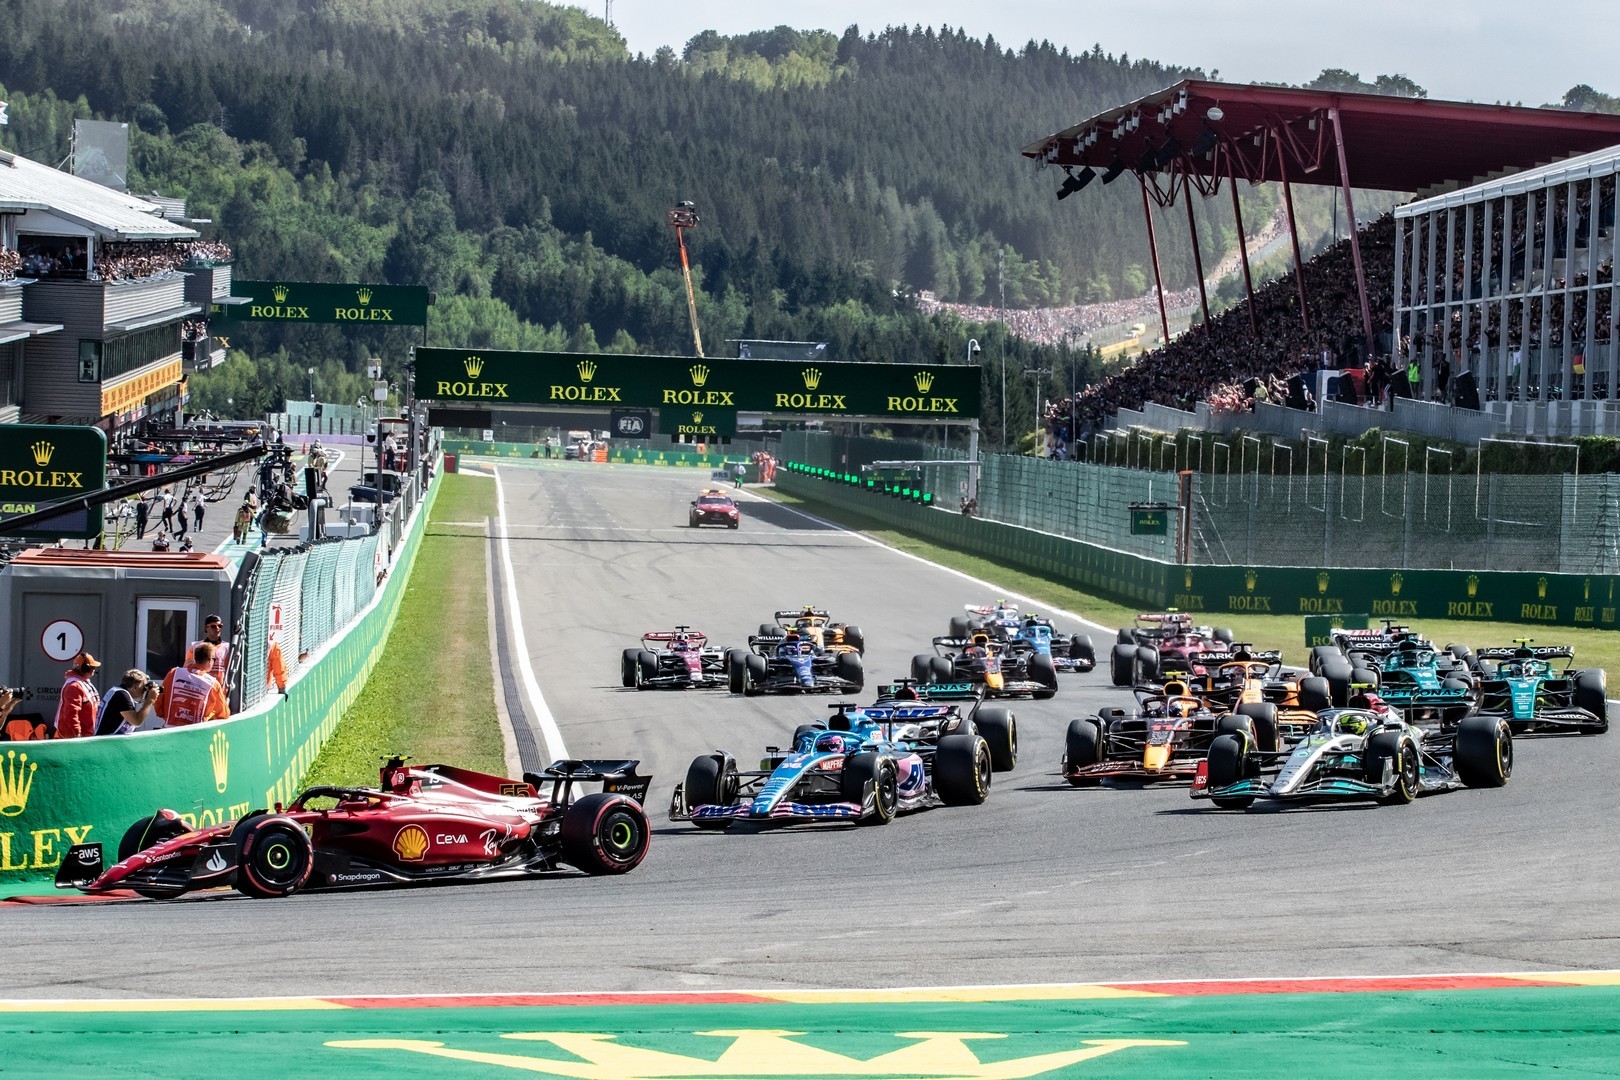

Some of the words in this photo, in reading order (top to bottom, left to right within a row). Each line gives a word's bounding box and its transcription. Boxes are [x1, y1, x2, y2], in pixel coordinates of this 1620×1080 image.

[251, 305, 310, 319] ROLEX
[335, 307, 393, 321] ROLEX
[436, 381, 509, 397] ROLEX
[550, 385, 622, 401] ROLEX
[663, 389, 734, 406] ROLEX
[776, 393, 847, 409] ROLEX
[887, 396, 959, 412] ROLEX
[678, 425, 717, 434] ROLEX
[0, 470, 83, 488] ROLEX
[0, 503, 36, 513] GIAN
[1174, 594, 1204, 609] ROLEX
[1229, 595, 1271, 610] ROLEX
[1300, 597, 1343, 613] ROLEX
[1372, 600, 1417, 615] ROLEX
[1448, 601, 1493, 617] ROLEX
[1521, 603, 1557, 620] ROLEX
[1574, 606, 1594, 622] ROLEX
[57, 632, 66, 651] 1
[1199, 652, 1273, 660] DARKACE
[822, 759, 844, 770] MAPFRE
[500, 783, 531, 798] 55
[78, 848, 99, 860] aws
[152, 851, 182, 862] Santander
[338, 873, 380, 881] Snapdragon
